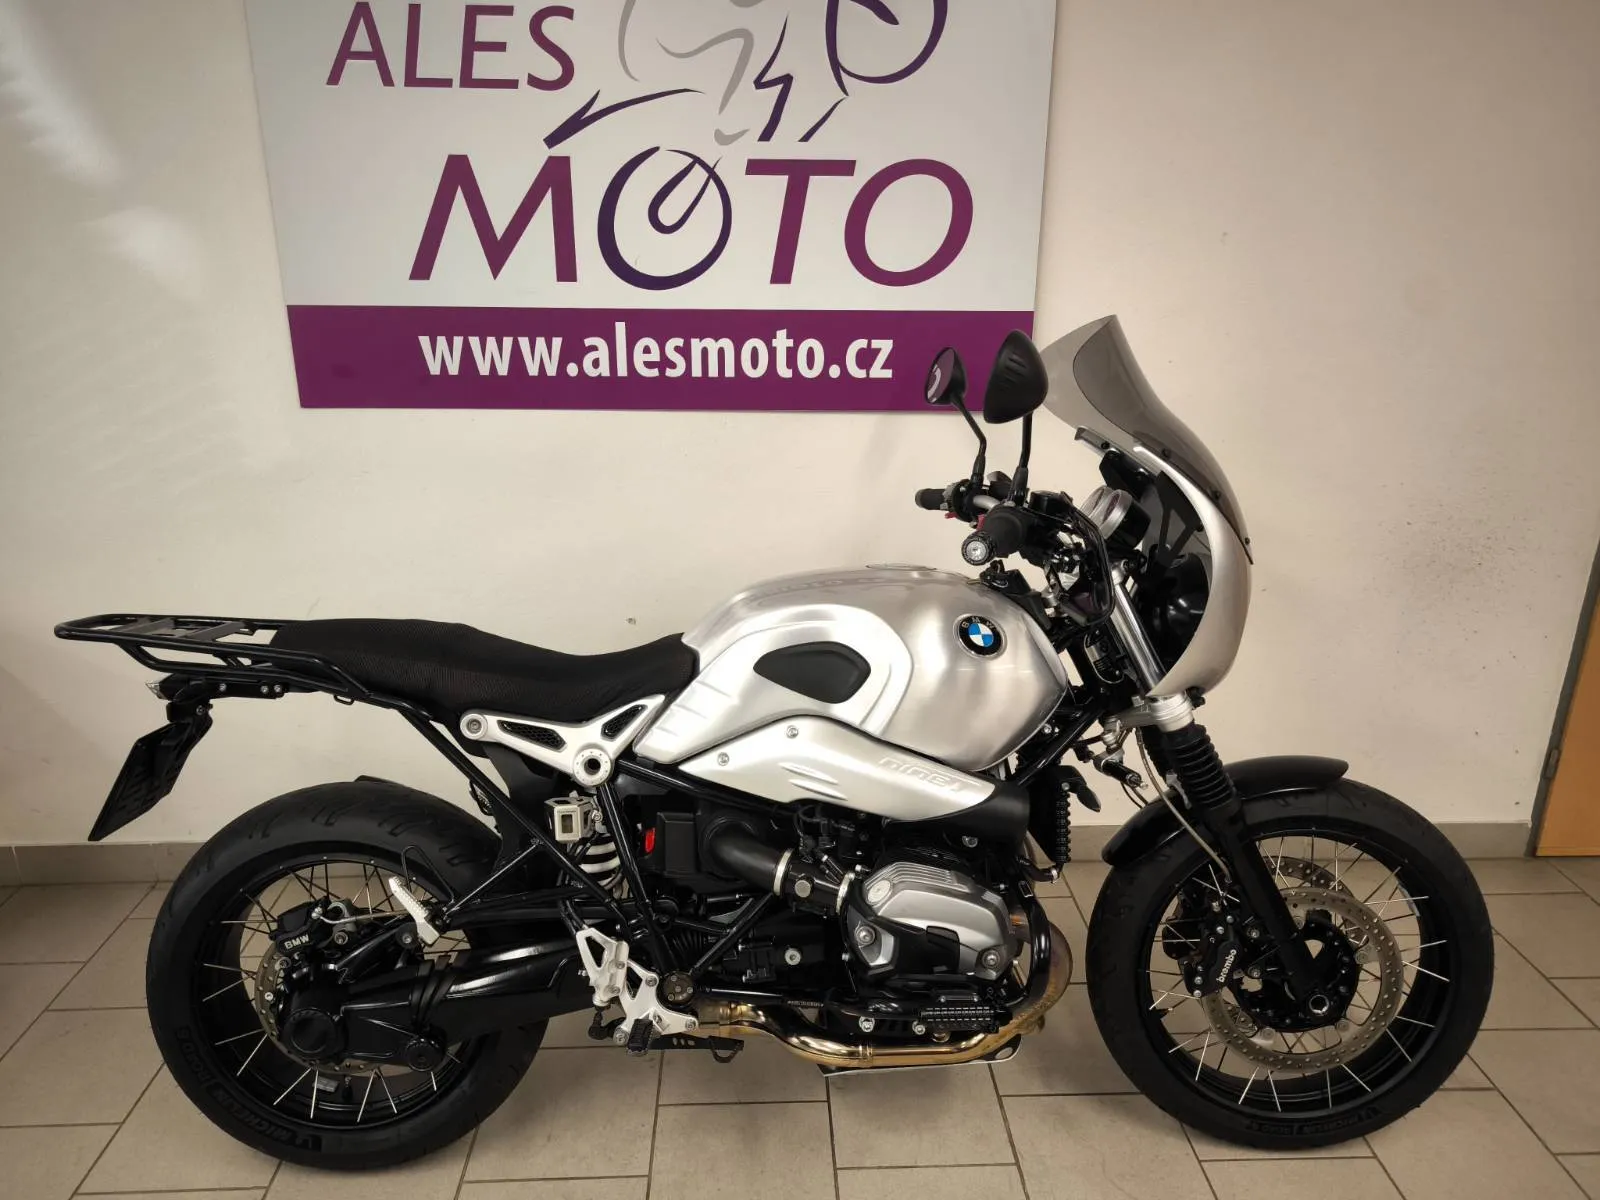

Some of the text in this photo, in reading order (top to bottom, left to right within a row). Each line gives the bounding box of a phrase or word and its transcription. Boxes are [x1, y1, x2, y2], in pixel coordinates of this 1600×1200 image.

[326, 1, 574, 90] ALES
[409, 147, 973, 289] MOTO
[418, 321, 893, 379] www.alesmoto.cz
[284, 932, 310, 950] BMW
[1215, 948, 1237, 983] brembo
[214, 1088, 295, 1143] MICHELIN
